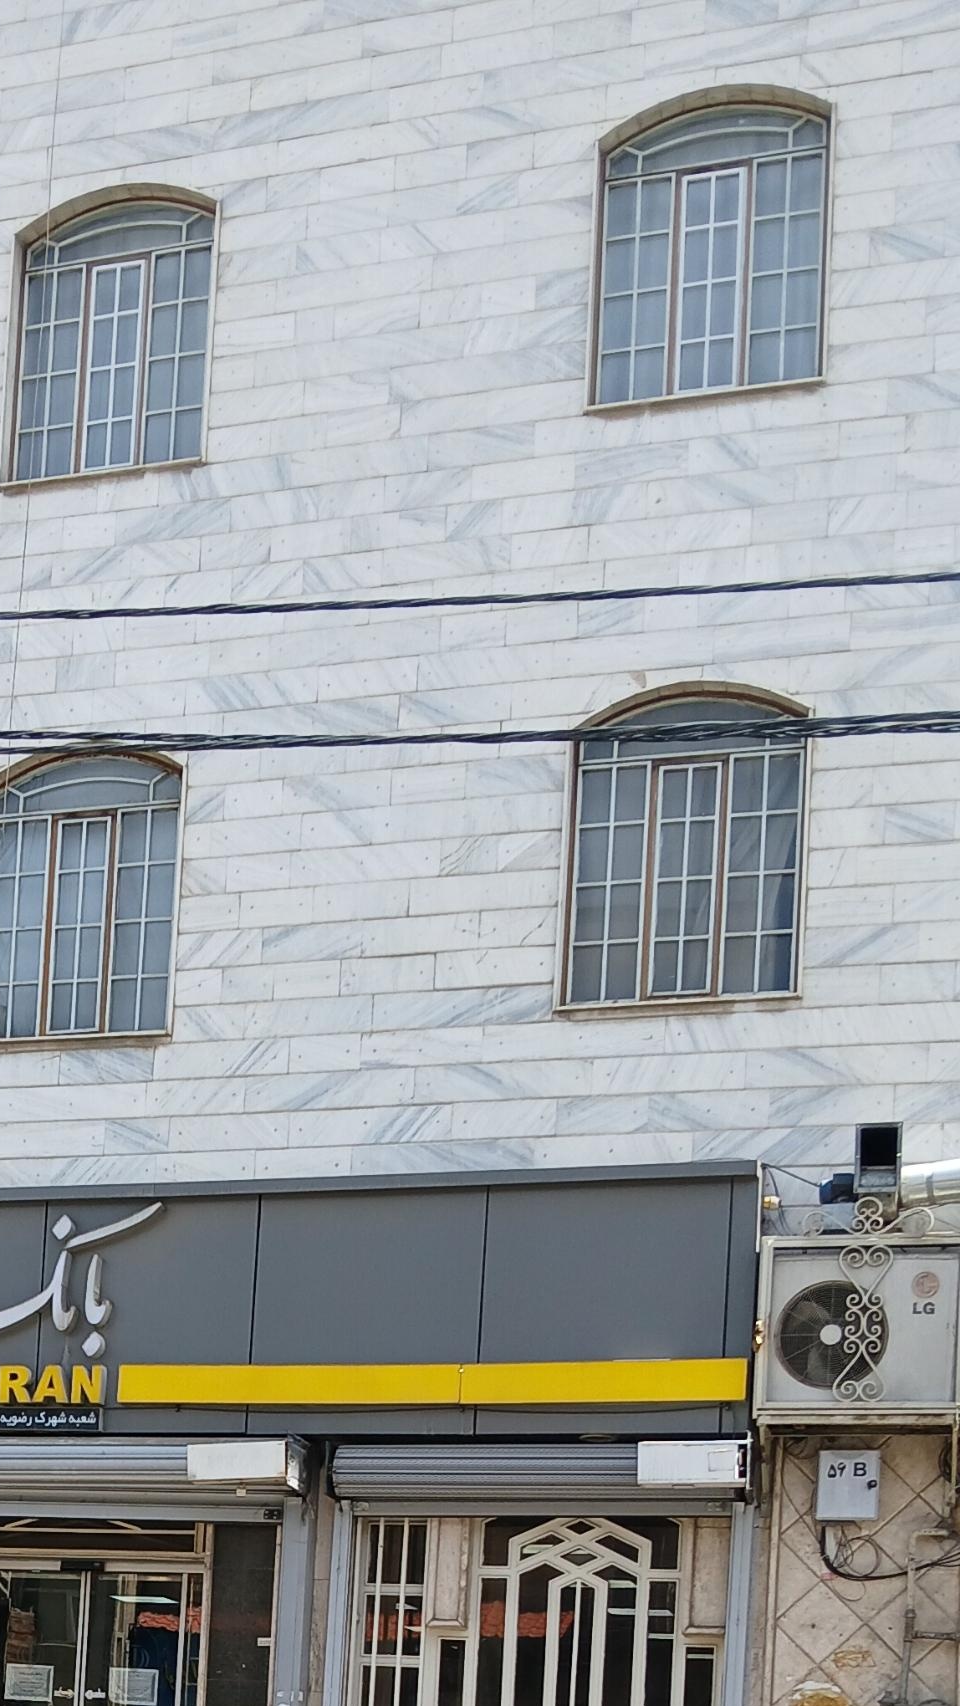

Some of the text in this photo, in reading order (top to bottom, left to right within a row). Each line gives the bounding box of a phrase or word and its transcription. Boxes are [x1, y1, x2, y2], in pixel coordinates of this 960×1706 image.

[912, 1301, 936, 1315] LG
[0, 1411, 97, 1428] شعبه شهرک رضویه
[853, 1461, 868, 1477] B
